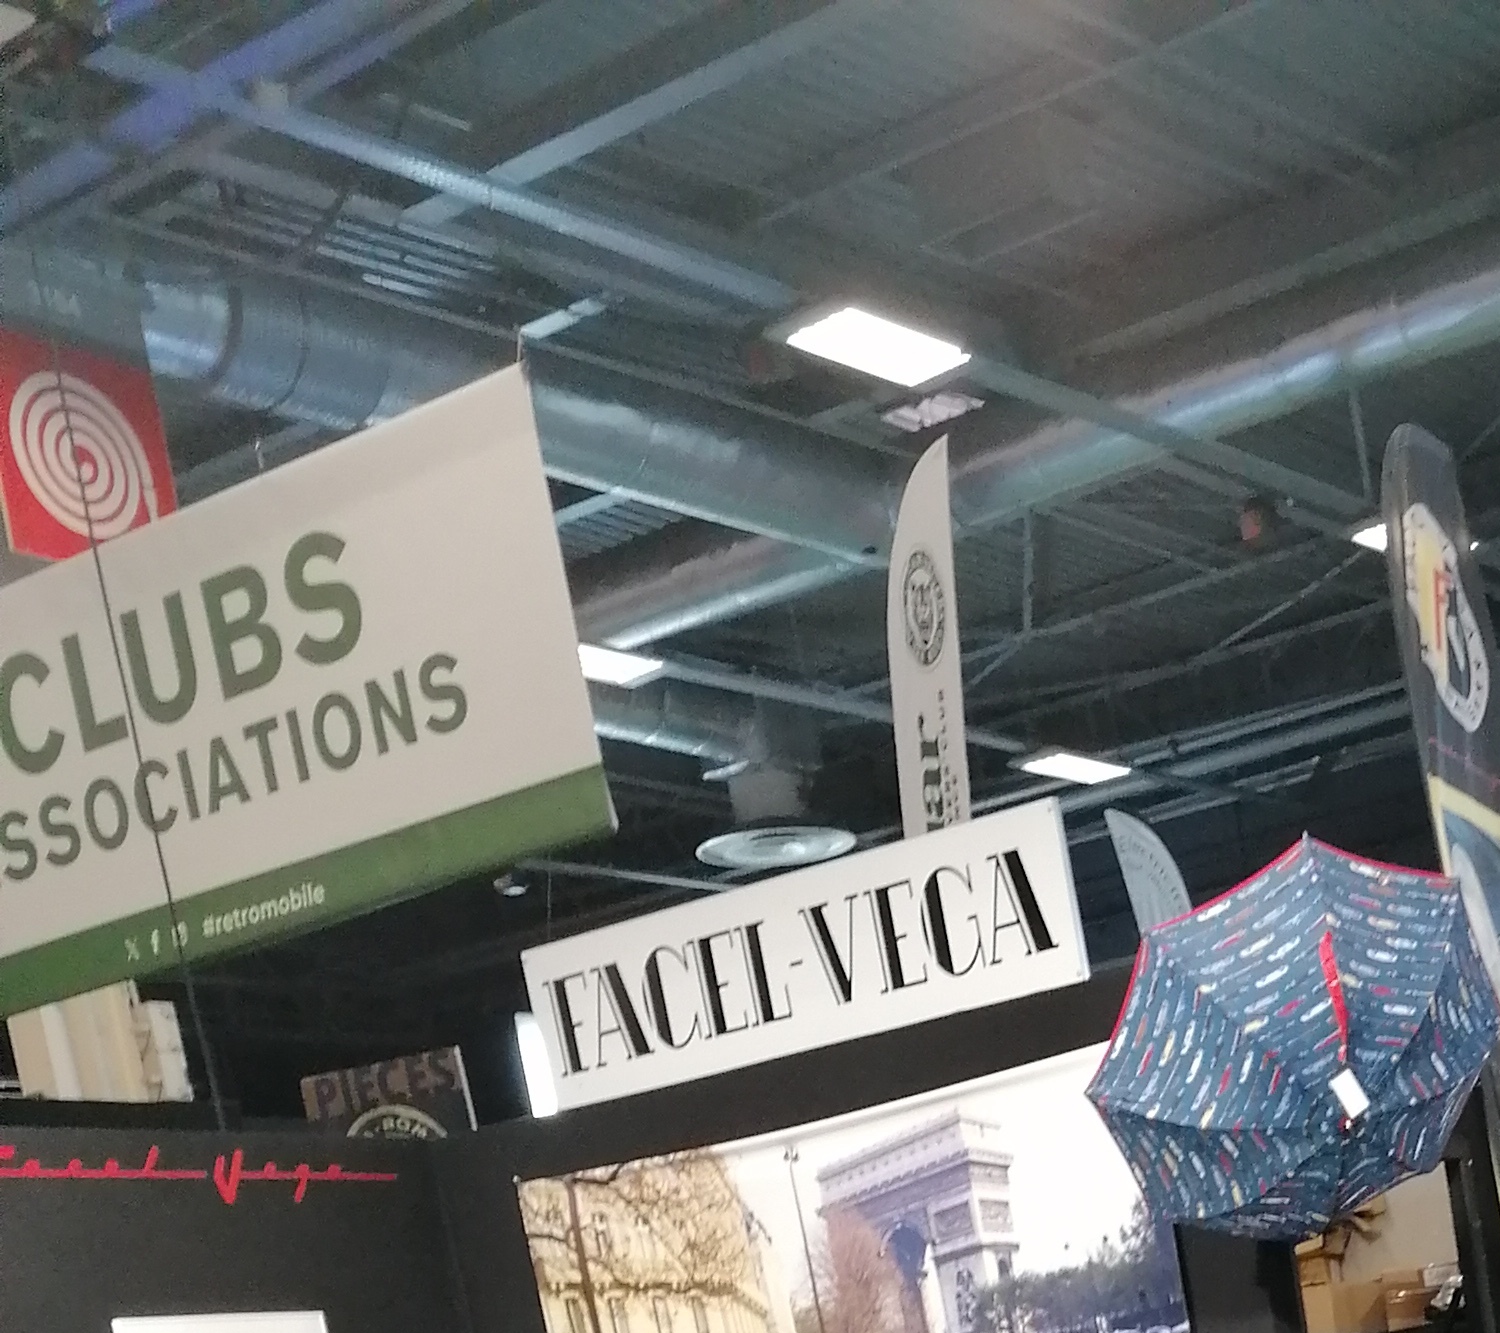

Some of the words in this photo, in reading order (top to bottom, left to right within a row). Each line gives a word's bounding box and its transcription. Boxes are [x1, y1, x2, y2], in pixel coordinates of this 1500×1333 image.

[0, 531, 363, 774] CLUBS
[0, 653, 468, 880] SSOCIATIONS
[202, 882, 325, 938] #retromobile
[543, 848, 1059, 1077] FACEL-VEGA
[213, 1150, 398, 1204] Vega
